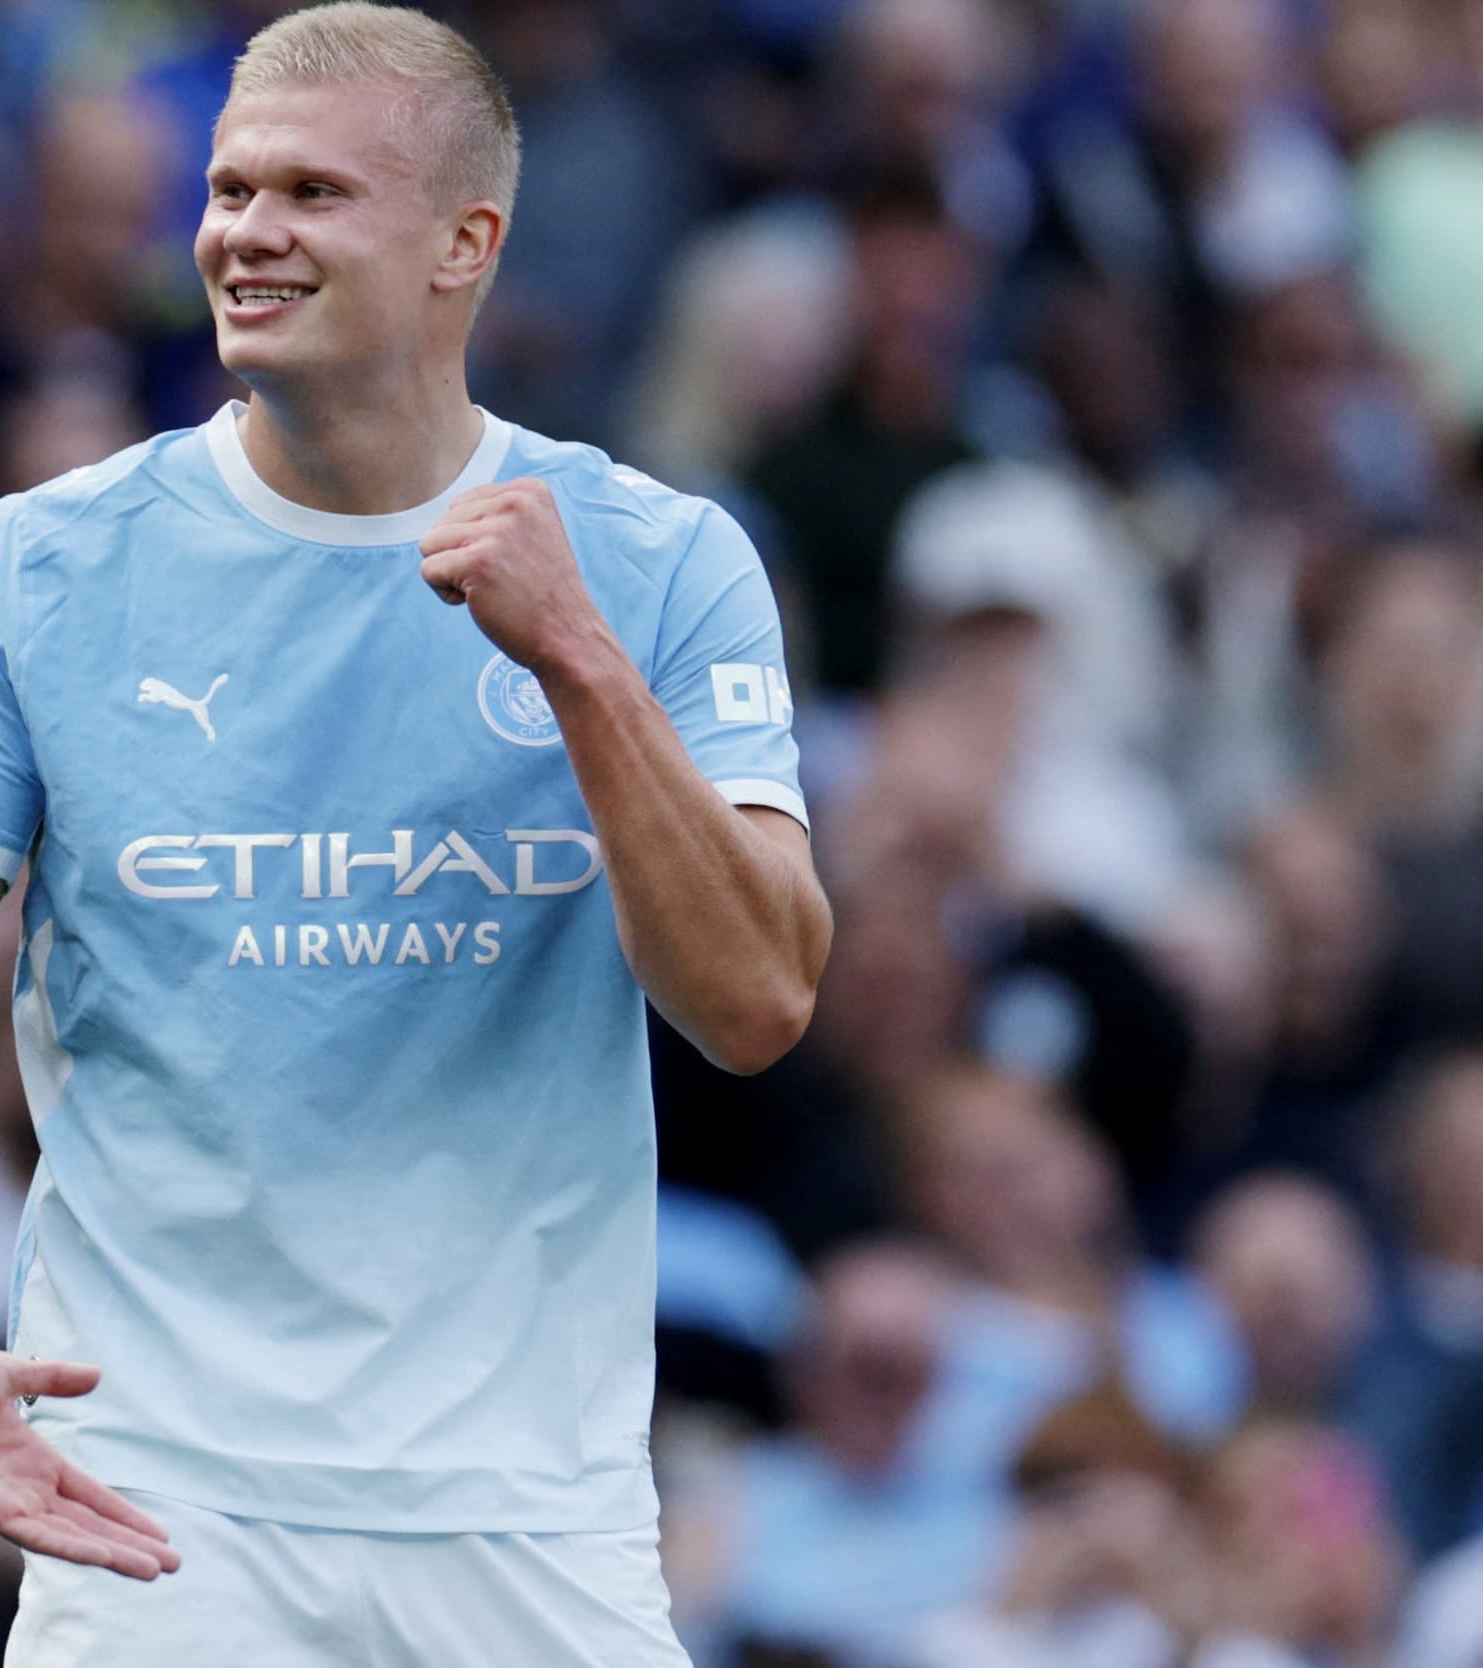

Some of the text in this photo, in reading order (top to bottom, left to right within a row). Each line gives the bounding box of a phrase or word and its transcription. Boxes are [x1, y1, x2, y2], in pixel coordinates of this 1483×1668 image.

[518, 728, 549, 737] CITY
[116, 829, 604, 899] ETIHAD
[228, 921, 501, 966] AIRWAYS
